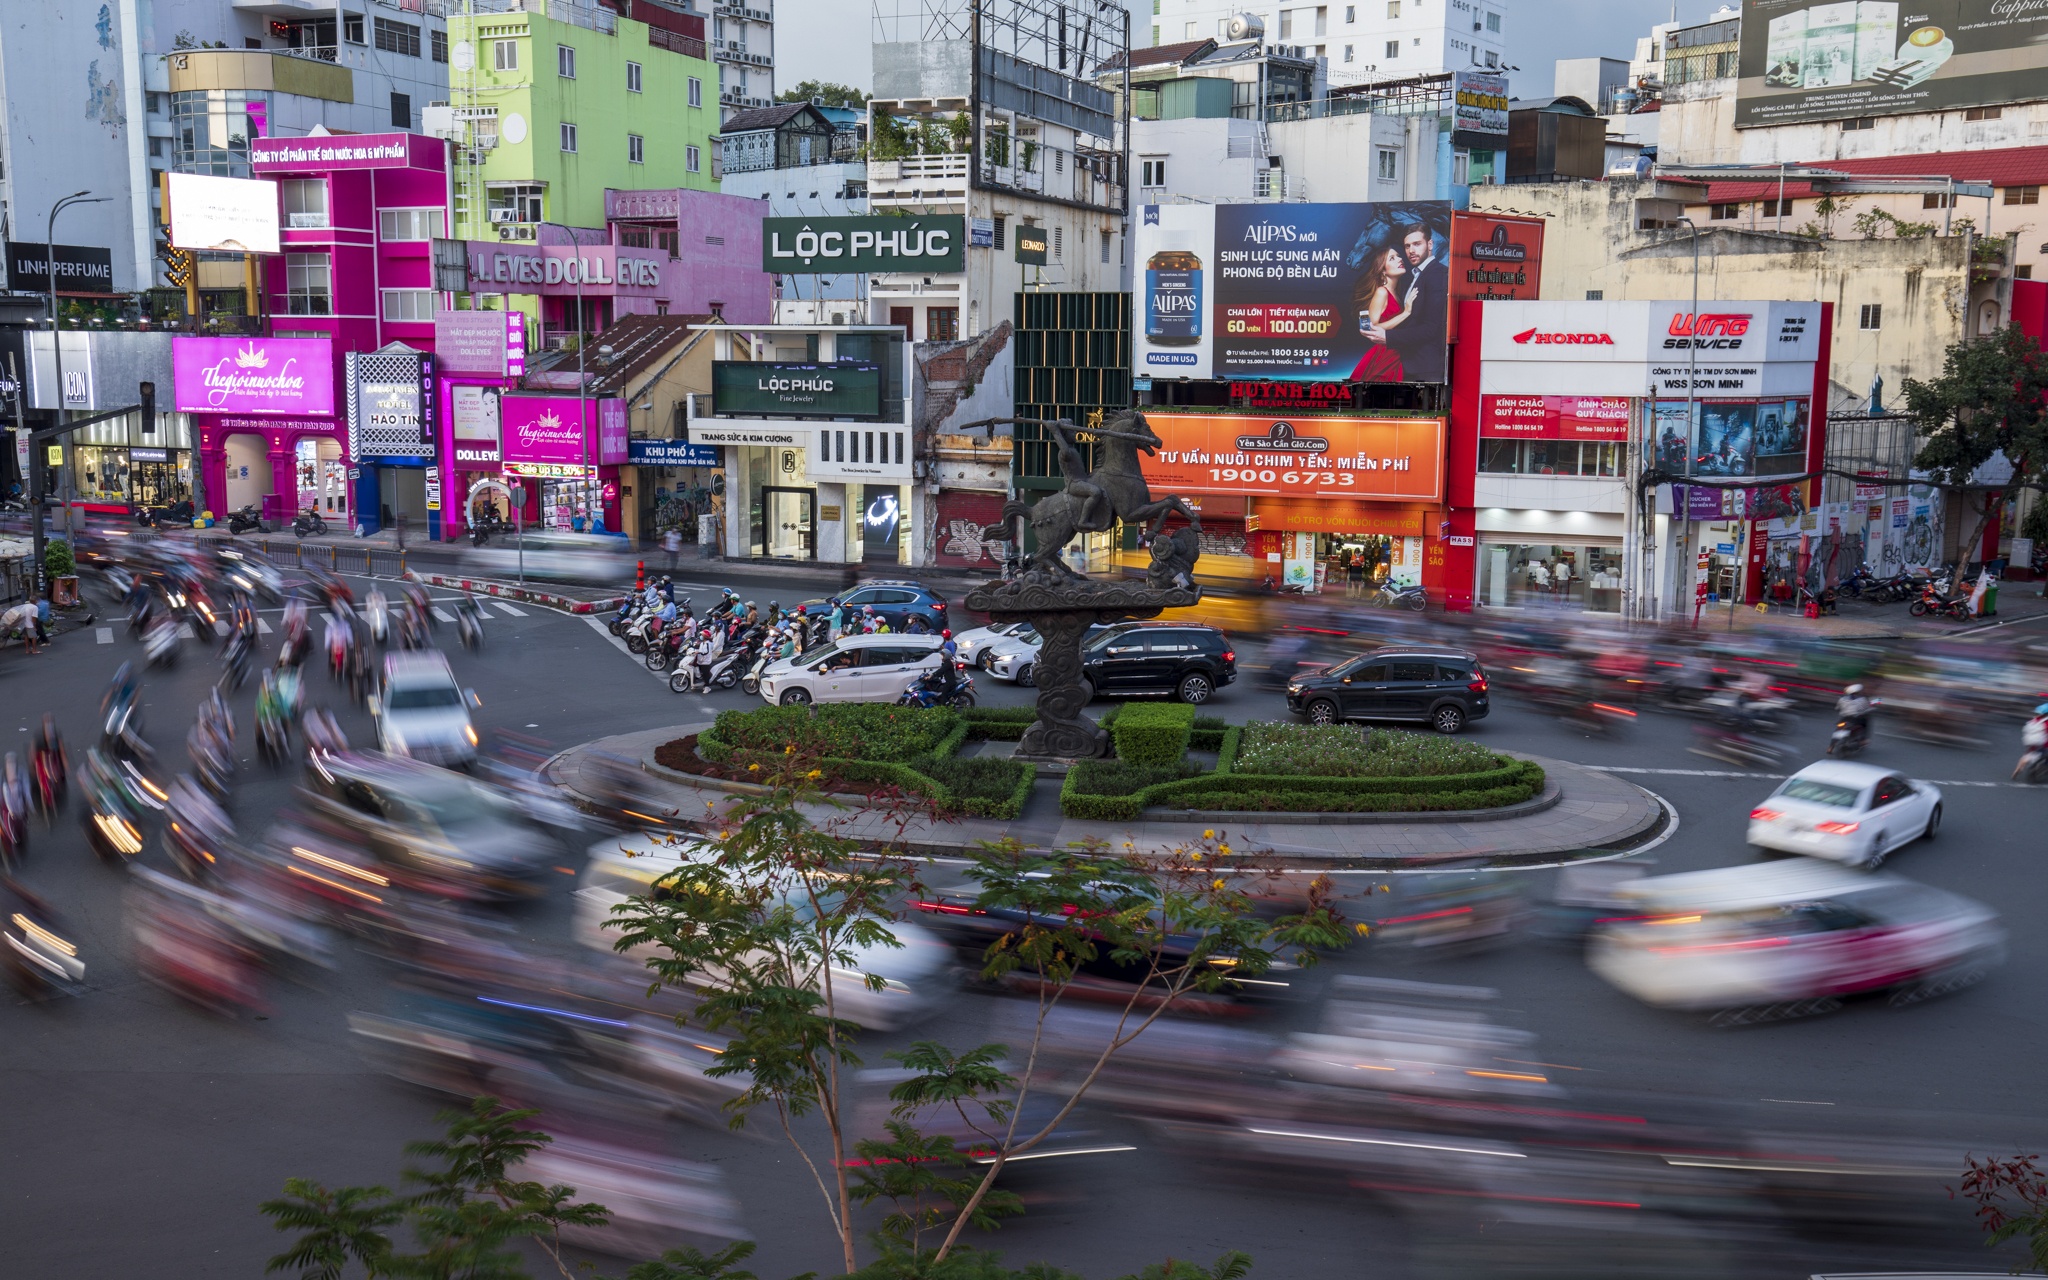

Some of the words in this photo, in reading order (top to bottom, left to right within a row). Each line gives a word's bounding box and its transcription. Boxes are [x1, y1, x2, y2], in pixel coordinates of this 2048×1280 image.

[253, 148, 269, 162] CÔNG
[271, 151, 279, 162] TY
[280, 146, 289, 162] CỔ
[290, 148, 307, 162] PHẦN
[308, 146, 321, 161] THẾ
[322, 148, 334, 160] GIỚI
[335, 146, 352, 160] NƯỚC
[354, 148, 367, 159] HOA
[368, 148, 373, 159] &
[373, 145, 384, 158] MỸ
[385, 142, 404, 158] PHẨM
[1146, 212, 1158, 220] MỚI
[1299, 231, 1317, 241] MỚI
[772, 224, 844, 265] LỘC
[851, 222, 950, 257] PHÚC
[1022, 240, 1045, 251] LEONARDO
[1221, 251, 1248, 261] SINH
[1251, 249, 1273, 264] LỰC
[1276, 251, 1308, 261] SUNG
[1312, 248, 1340, 261] MÃN
[18, 260, 48, 274] LINH
[54, 262, 110, 278] PERFUME
[494, 254, 543, 284] EYES
[545, 256, 613, 285] DOLL
[618, 257, 660, 286] EYES
[1223, 267, 1263, 278] PHONG
[1267, 264, 1284, 280] ĐỘ
[1287, 264, 1310, 277] BỀN
[1314, 265, 1337, 278] LÂU
[1247, 308, 1262, 316] LỚN
[1269, 307, 1286, 316] TIẾT
[1287, 308, 1307, 318] KIỆM
[509, 313, 521, 326] THẾ
[1228, 320, 1245, 333] 60
[509, 330, 522, 343] GIỚI
[1534, 333, 1614, 345] HONDA
[508, 347, 524, 359] NƯỚC
[510, 365, 522, 376] HOA
[65, 372, 86, 396] ICON
[202, 358, 304, 406] Thegioinuochoa
[759, 375, 789, 394] LỘC
[792, 375, 834, 391] PHÚC
[1664, 380, 1687, 388] WSS
[1693, 379, 1715, 388] SƠN
[1718, 380, 1743, 388] MINH
[366, 386, 418, 394] APARTMEN
[1309, 384, 1352, 399] HOA
[423, 362, 432, 436] HOTEL
[793, 395, 814, 403] Jewelry
[1496, 398, 1516, 407] KÍNH
[1518, 398, 1544, 407] CHÀO
[1578, 399, 1598, 408] KÍNH
[1601, 400, 1627, 409] CHÀO
[371, 412, 396, 424] HÀO
[1495, 408, 1512, 417] QUÝ
[1514, 408, 1544, 417] KHÁCH
[1576, 409, 1593, 418] QUÝ
[1596, 409, 1628, 418] KHÁCH
[517, 421, 583, 448] Thegioinuochoa
[727, 432, 741, 441] SỨC
[765, 435, 793, 443] CƯƠNG
[1257, 439, 1271, 448] Sào
[1273, 439, 1289, 448] Cần
[1291, 440, 1325, 449] Giờ.Com
[50, 448, 62, 460] ICON
[457, 450, 499, 461] DOLLEYE
[646, 447, 664, 456] KHU
[667, 444, 686, 456] PHỐ
[689, 448, 695, 457] 4
[1159, 451, 1178, 463] TƯ
[1182, 448, 1210, 464] VẤN
[1215, 451, 1249, 466] NUÔI
[1255, 454, 1293, 467] CHIM
[1298, 453, 1333, 468] YẾN:
[1338, 452, 1377, 470] MIỄN
[1382, 456, 1411, 471] PHÍ
[519, 464, 537, 473] Sale
[539, 466, 551, 476] up
[552, 466, 560, 474] to
[562, 466, 581, 476] 50%
[1210, 469, 1276, 482] 1900
[1282, 471, 1355, 486] 6733
[1262, 533, 1276, 542] YẾN
[1262, 544, 1276, 553] SÀO
[1429, 544, 1443, 554] YẾN
[1429, 556, 1443, 565] SÀO
